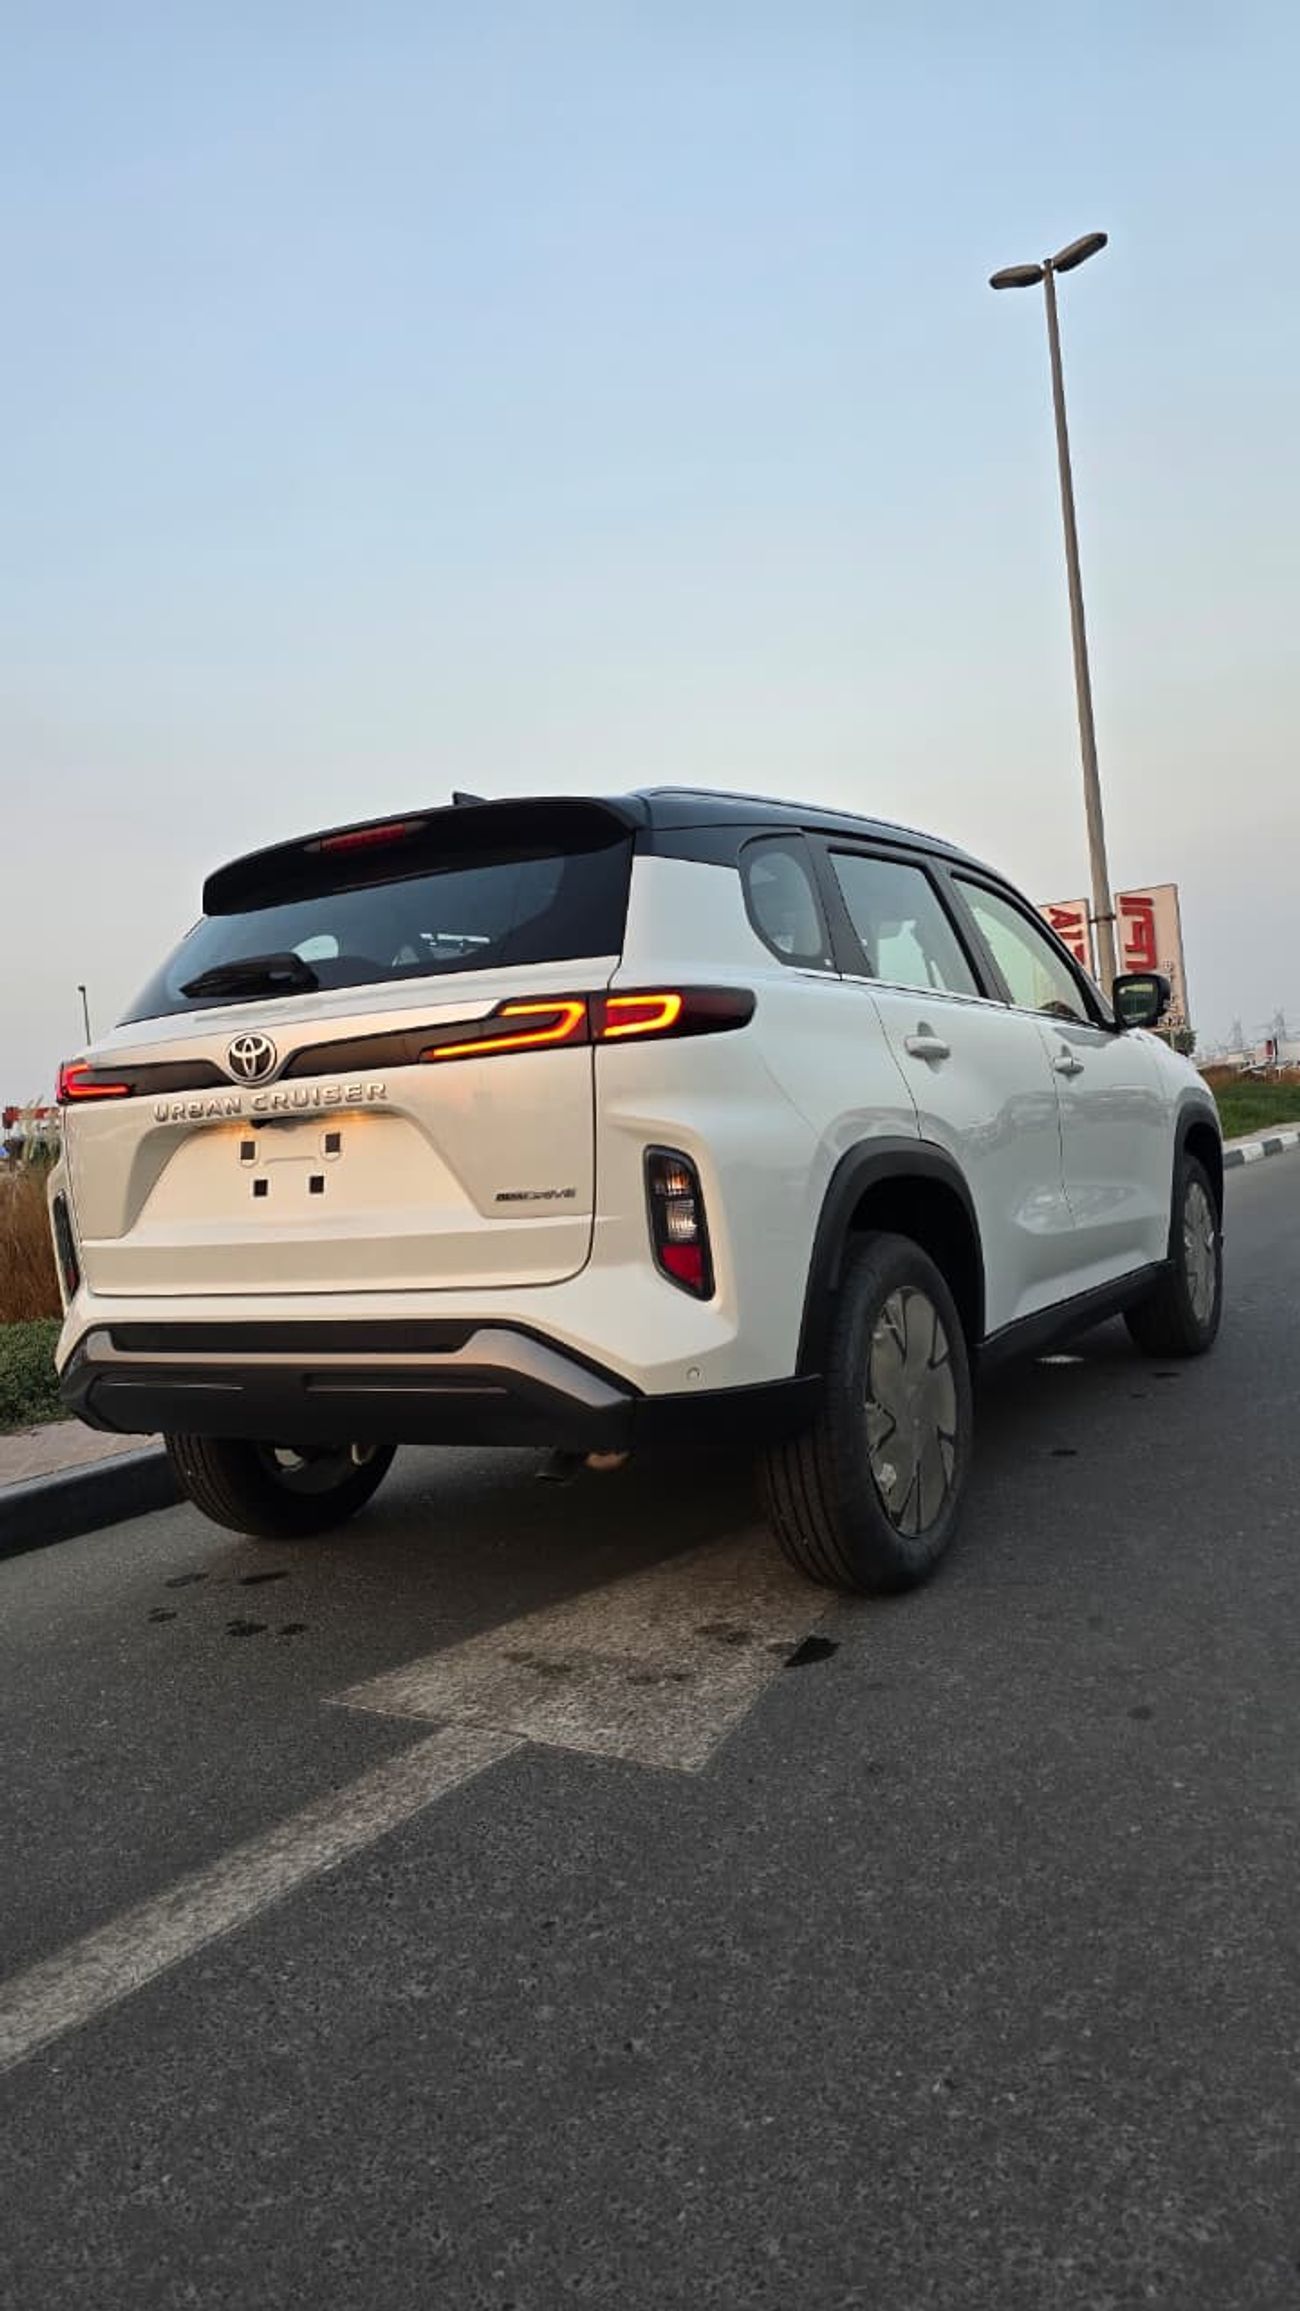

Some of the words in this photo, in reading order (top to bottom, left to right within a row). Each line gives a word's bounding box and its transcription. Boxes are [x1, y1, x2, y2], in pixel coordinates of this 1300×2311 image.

[1119, 896, 1157, 973] الطا
[153, 1098, 243, 1122] URBAN
[250, 1082, 388, 1112] CRUISER
